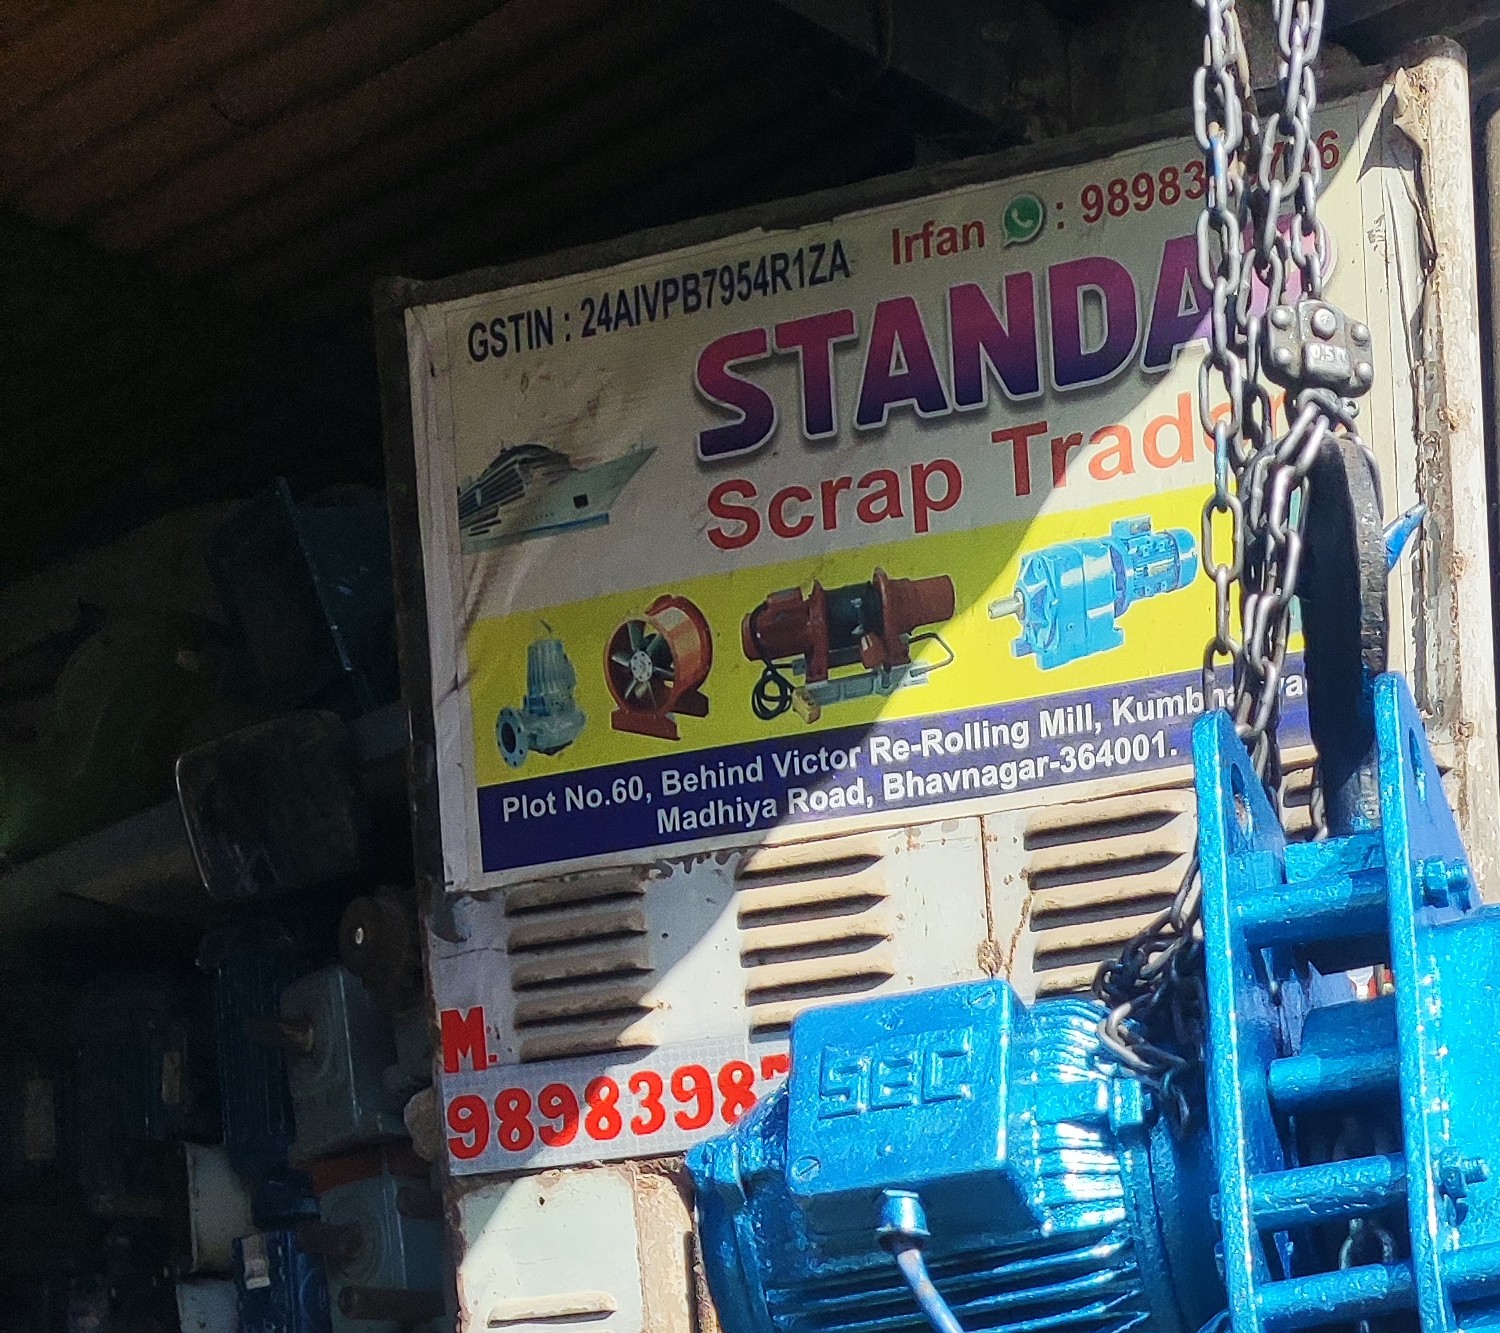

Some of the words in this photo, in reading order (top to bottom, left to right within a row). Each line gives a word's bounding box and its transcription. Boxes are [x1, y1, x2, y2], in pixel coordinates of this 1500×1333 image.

[891, 218, 987, 266] Irfan
[1079, 128, 1340, 225] 9898376
[467, 305, 554, 363] GSTIN
[579, 239, 851, 339] 24AIVPB7954R1ZA
[696, 212, 1337, 461] STANDA
[707, 457, 963, 550] Scrap
[502, 790, 557, 824] Plot
[564, 774, 653, 813] No.60,
[660, 755, 764, 797] Behind
[770, 743, 862, 779] Victor
[868, 717, 1030, 767] Re-Rolling
[1038, 702, 1102, 742] Mill,
[656, 795, 778, 835] Madhiya
[787, 776, 874, 815] Road,
[881, 731, 1180, 802] Bhavnagar-364001.
[439, 1005, 499, 1074] M.
[447, 1053, 790, 1160] 9898398
